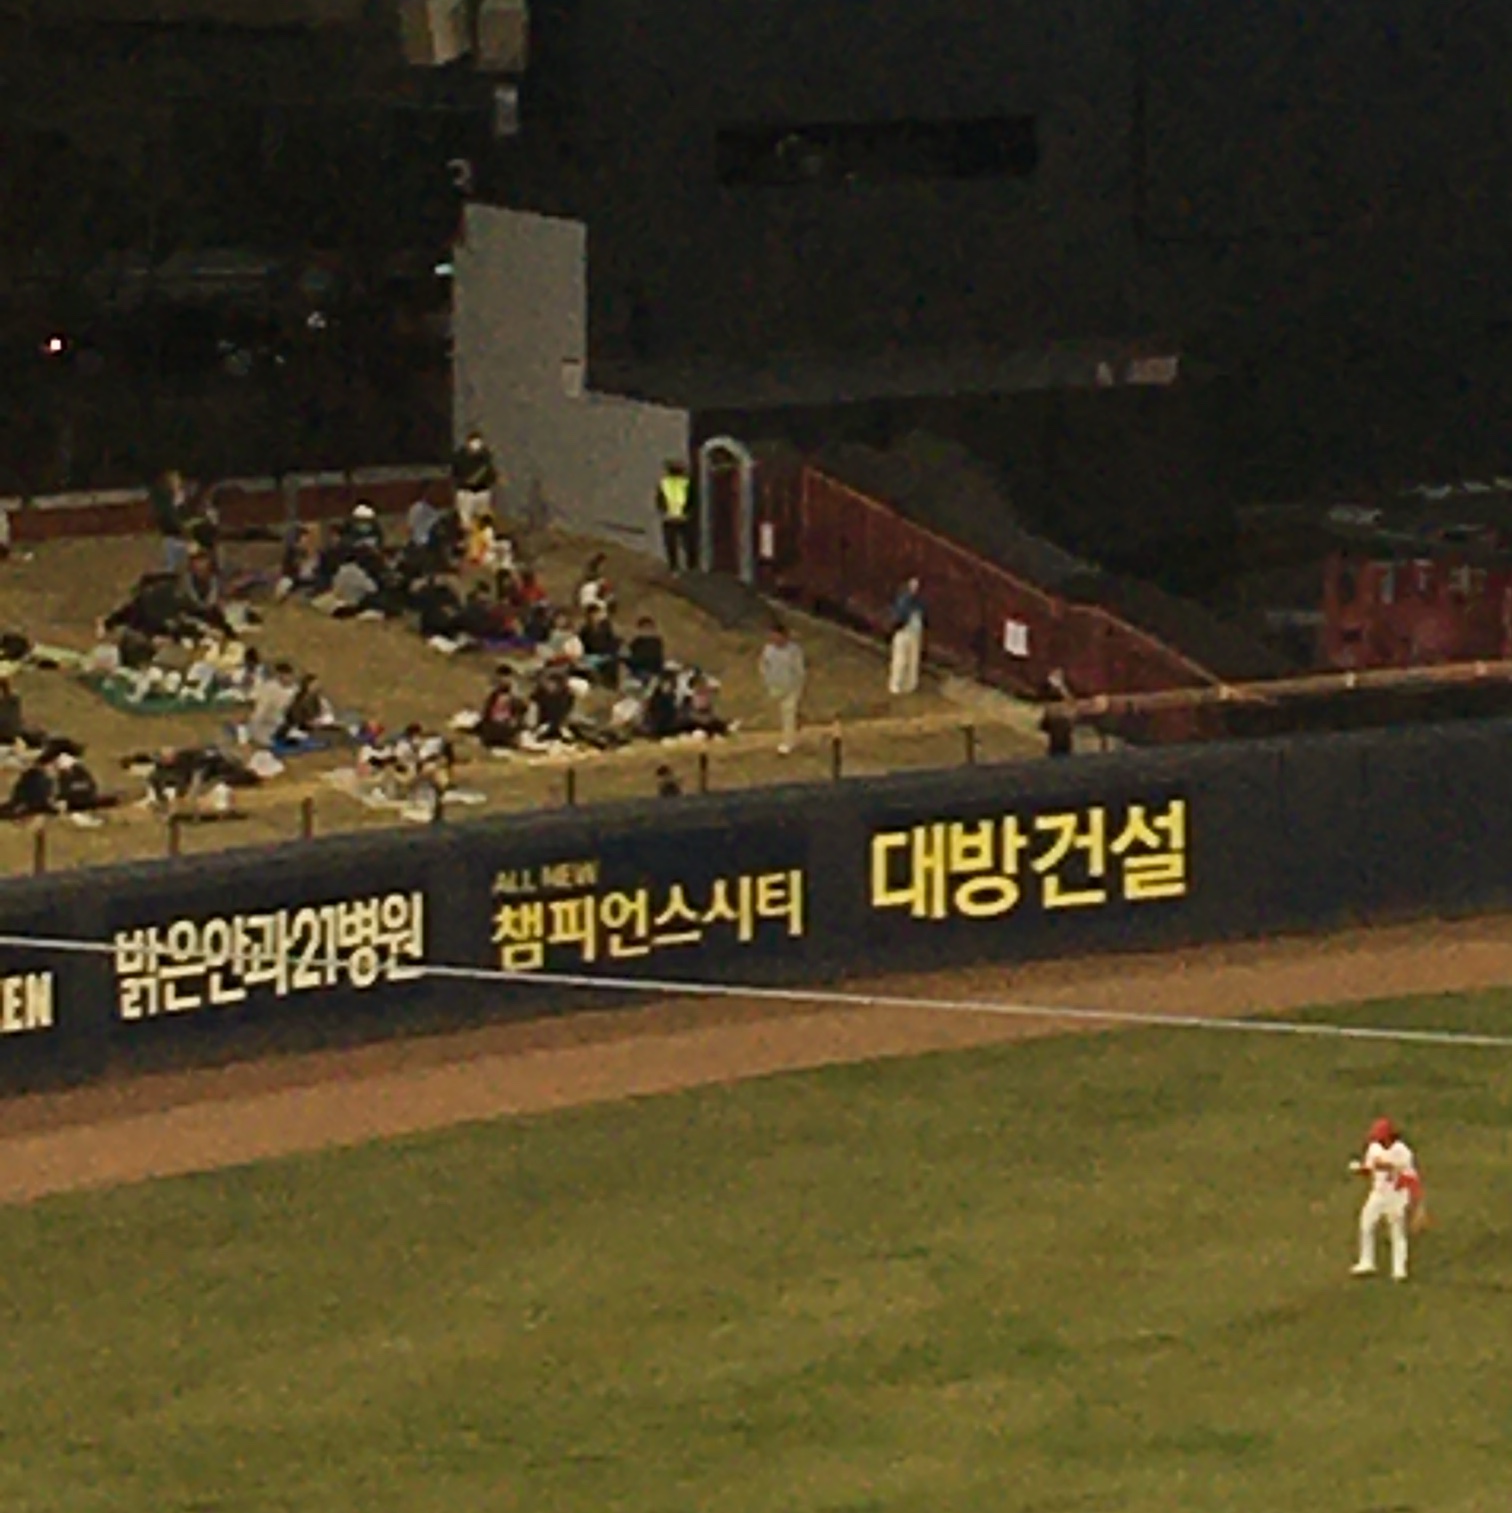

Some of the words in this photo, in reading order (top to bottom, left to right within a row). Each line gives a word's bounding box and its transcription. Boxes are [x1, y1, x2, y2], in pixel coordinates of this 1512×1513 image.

[871, 799, 1187, 919] 대방건설
[113, 890, 425, 1020] 밝은안과21병원
[490, 868, 804, 971] 챔피언스시티
